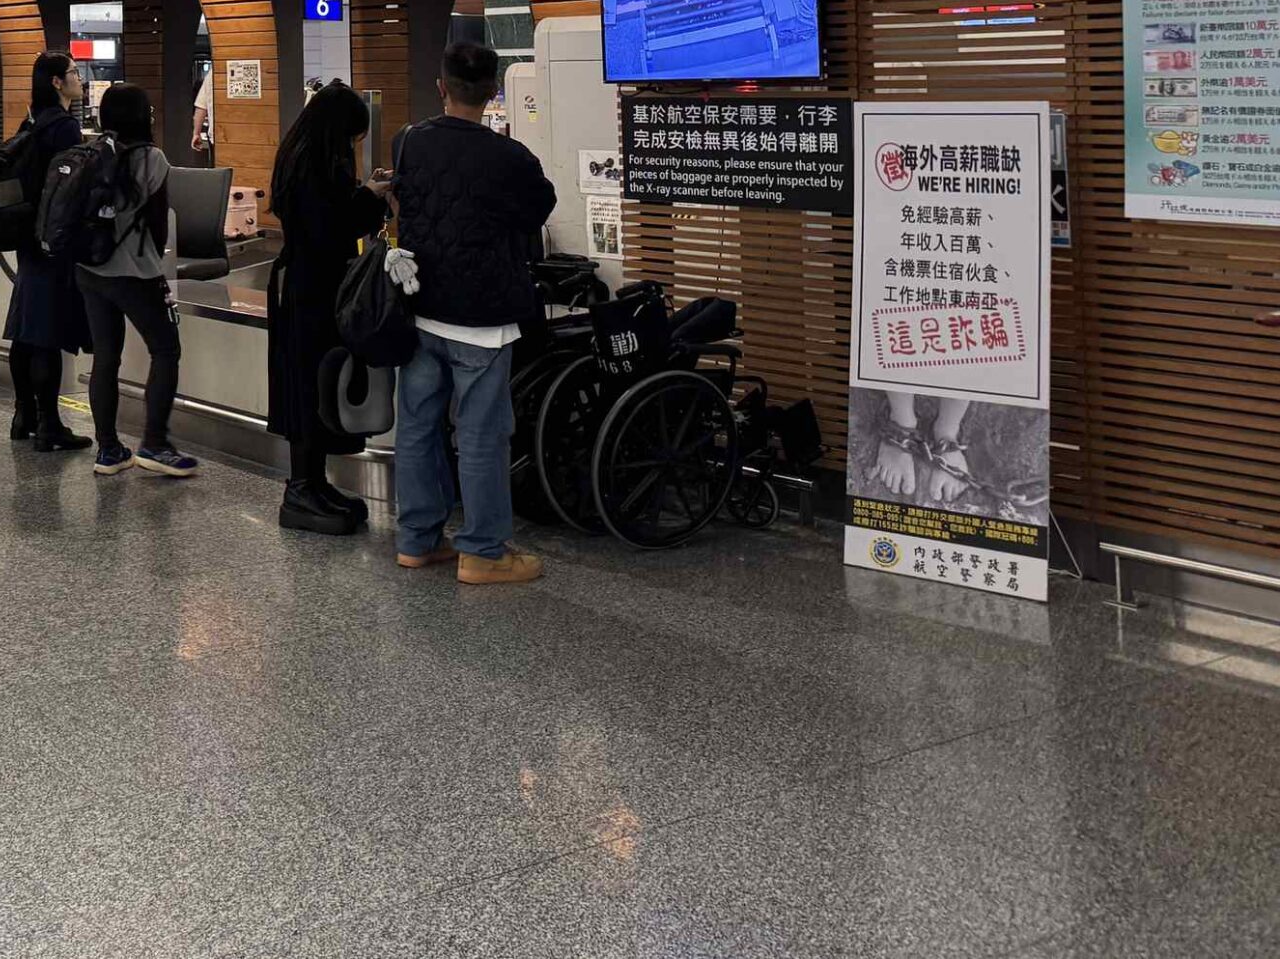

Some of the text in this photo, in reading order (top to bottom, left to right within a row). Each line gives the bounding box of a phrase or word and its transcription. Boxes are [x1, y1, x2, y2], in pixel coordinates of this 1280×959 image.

[633, 130, 838, 154] 完成安檢無異後始得離開
[629, 154, 844, 175] For security reasons, please ensure that your
[900, 144, 1021, 173] 海外高薪職缺
[629, 169, 844, 190] pieces of baggage are properly inspected by
[918, 176, 1021, 195] WE'RE HIRING!
[630, 182, 785, 204] the X-ray scanner before leaving.
[883, 286, 998, 311] 工作地點東南亞
[887, 312, 1009, 356] 這是詐騙
[914, 545, 1020, 577] 內政部警政署
[913, 561, 1019, 592] 航空警察局
